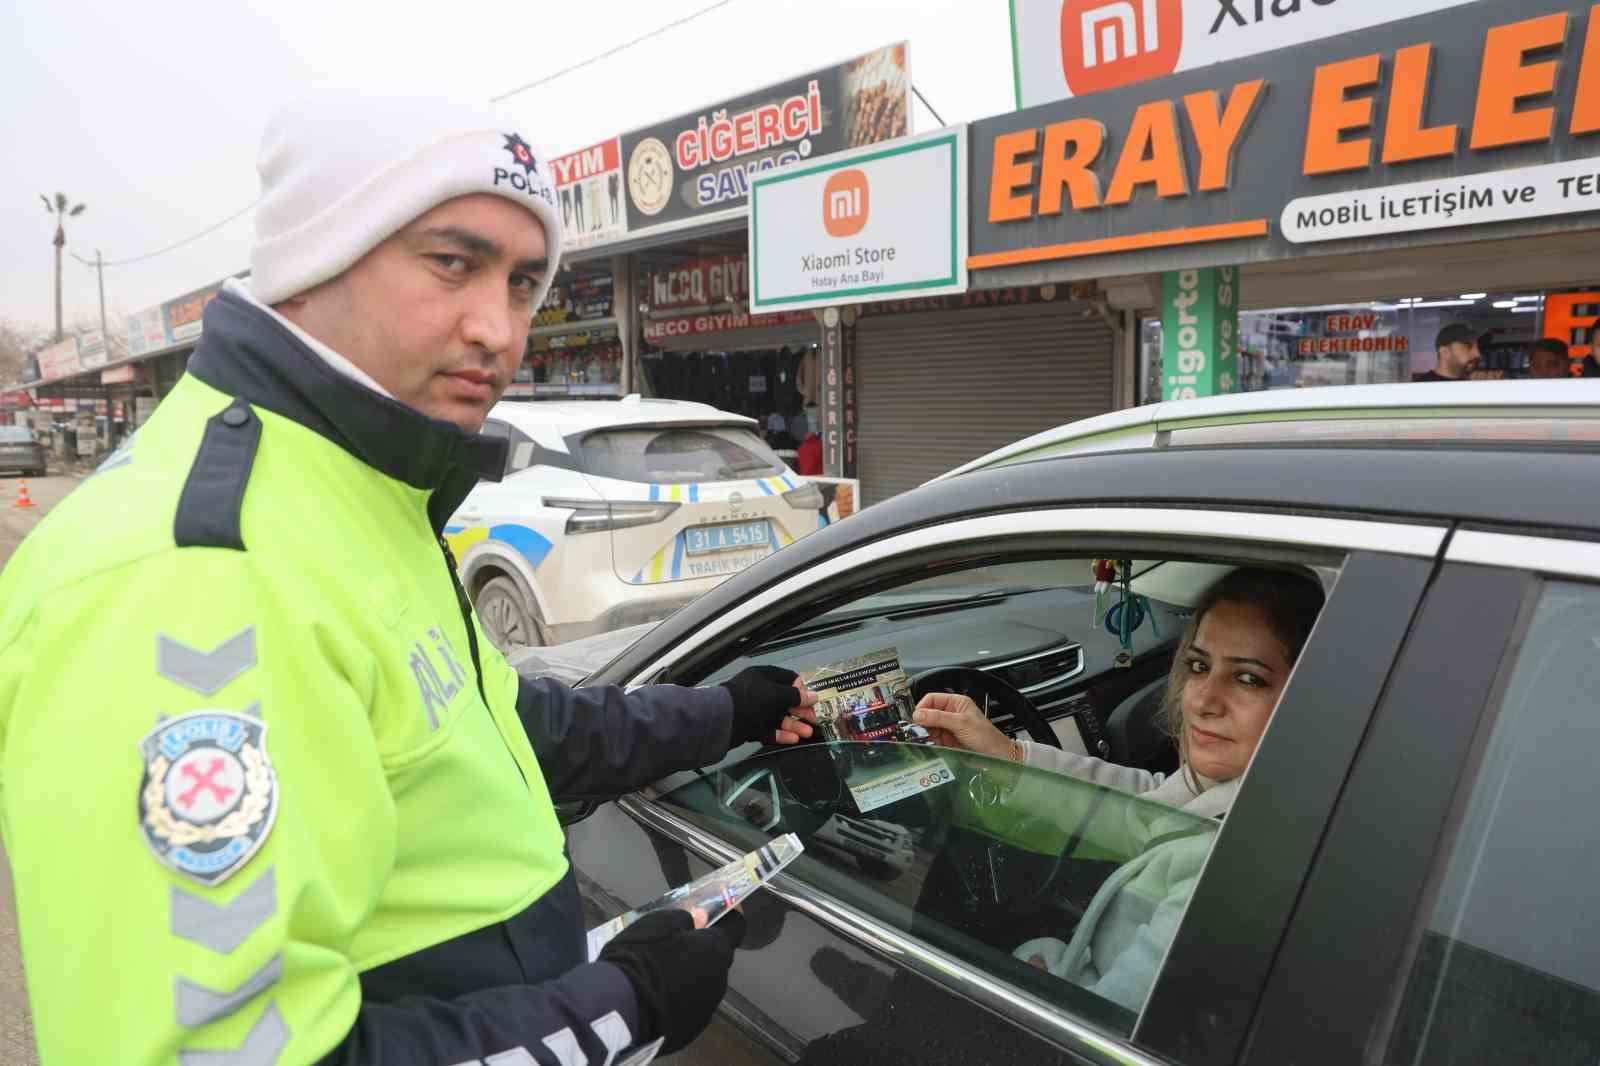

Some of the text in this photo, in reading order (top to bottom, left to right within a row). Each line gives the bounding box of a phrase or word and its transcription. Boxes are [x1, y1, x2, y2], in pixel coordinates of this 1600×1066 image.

[676, 80, 822, 170] CİĞERCİ
[549, 146, 604, 187] YİM
[988, 79, 1266, 224] ERAY
[1296, 174, 1600, 229] MOBİL İLETİŞİM ve TE
[801, 247, 896, 272] Xiaomi Store
[840, 273, 859, 285] Ana
[1327, 313, 1376, 331] ERAY
